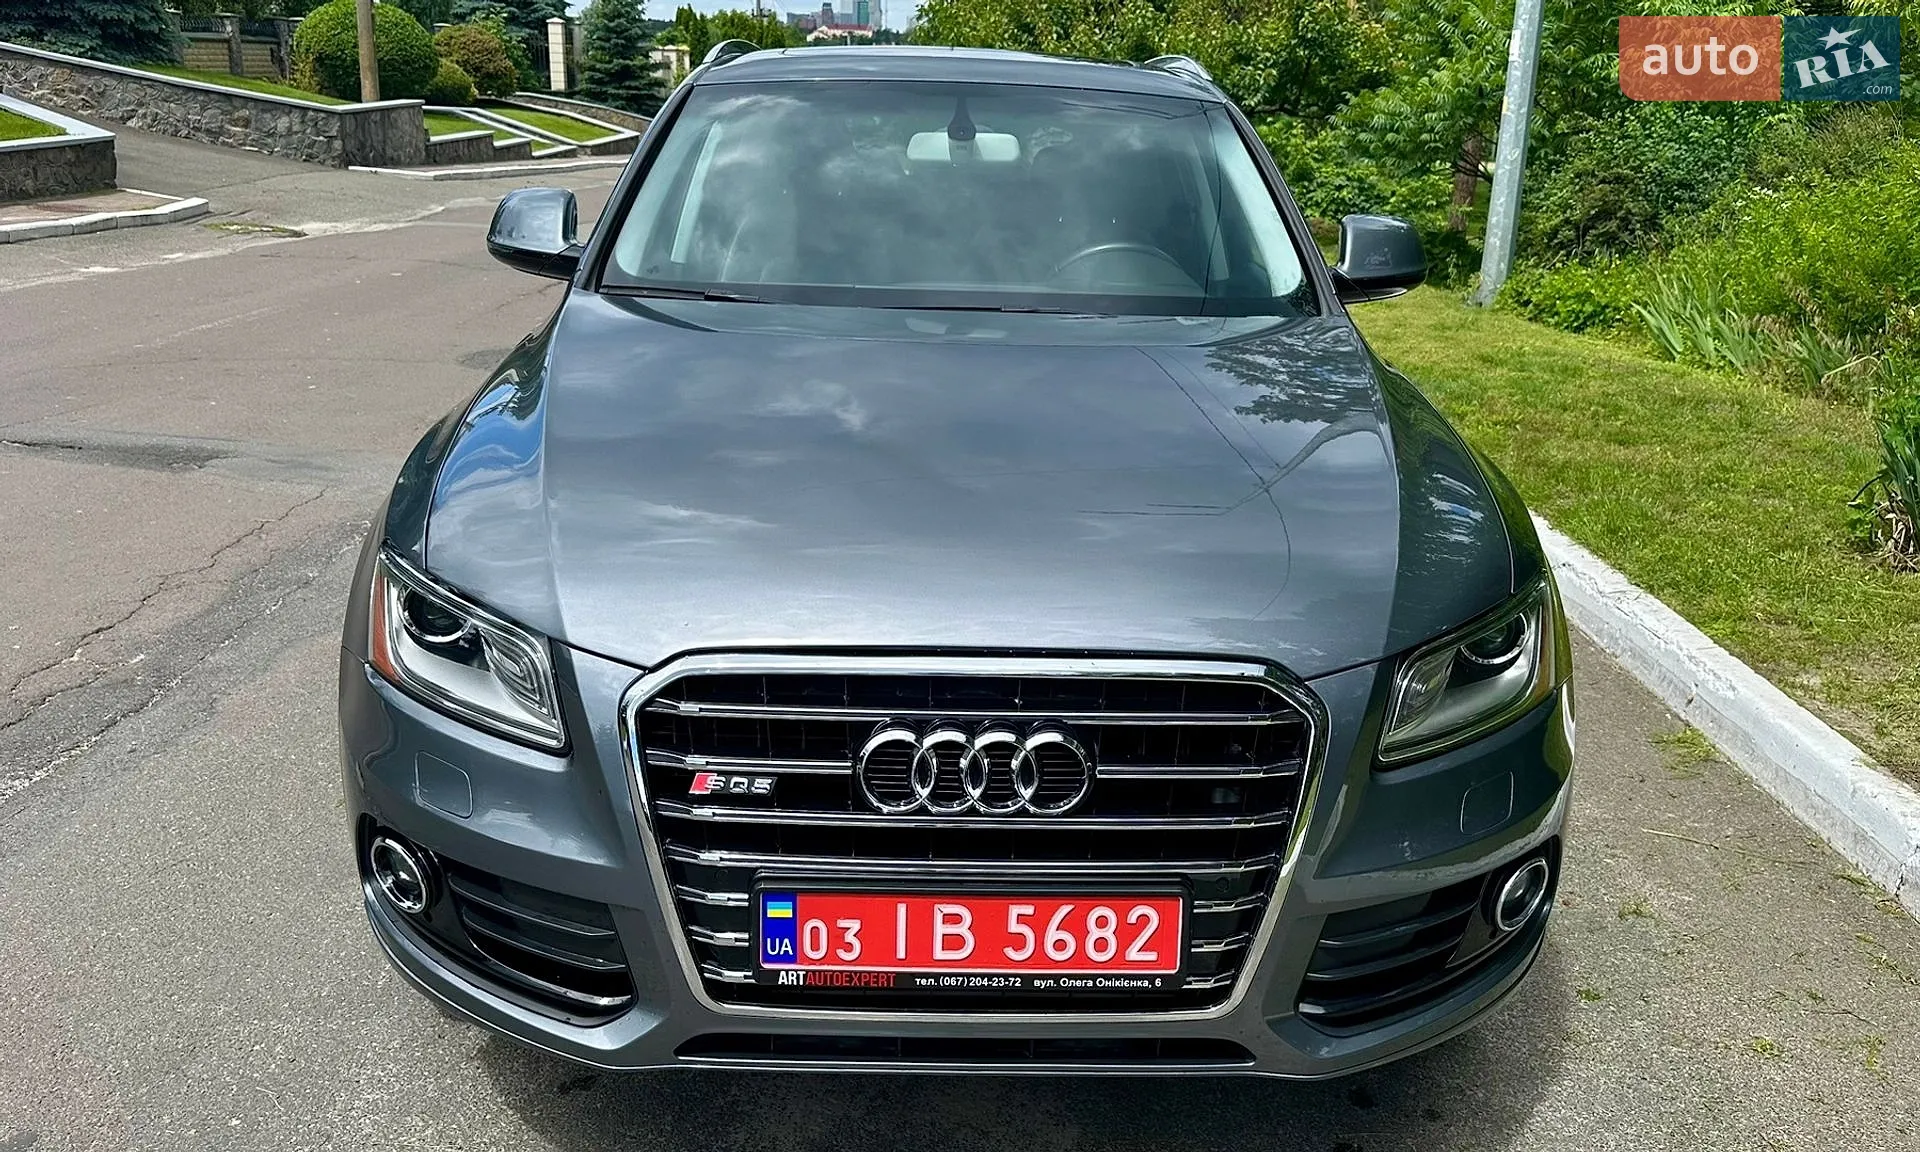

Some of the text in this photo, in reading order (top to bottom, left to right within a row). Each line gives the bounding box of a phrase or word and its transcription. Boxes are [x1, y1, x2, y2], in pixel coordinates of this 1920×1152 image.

[704, 775, 772, 794] SQ5
[803, 903, 1160, 962] 03 IB 5682
[767, 938, 793, 956] UA
[915, 977, 938, 986] тел.
[1033, 978, 1057, 988] вул.
[1060, 977, 1093, 988] Олега
[1155, 978, 1162, 987] 6
